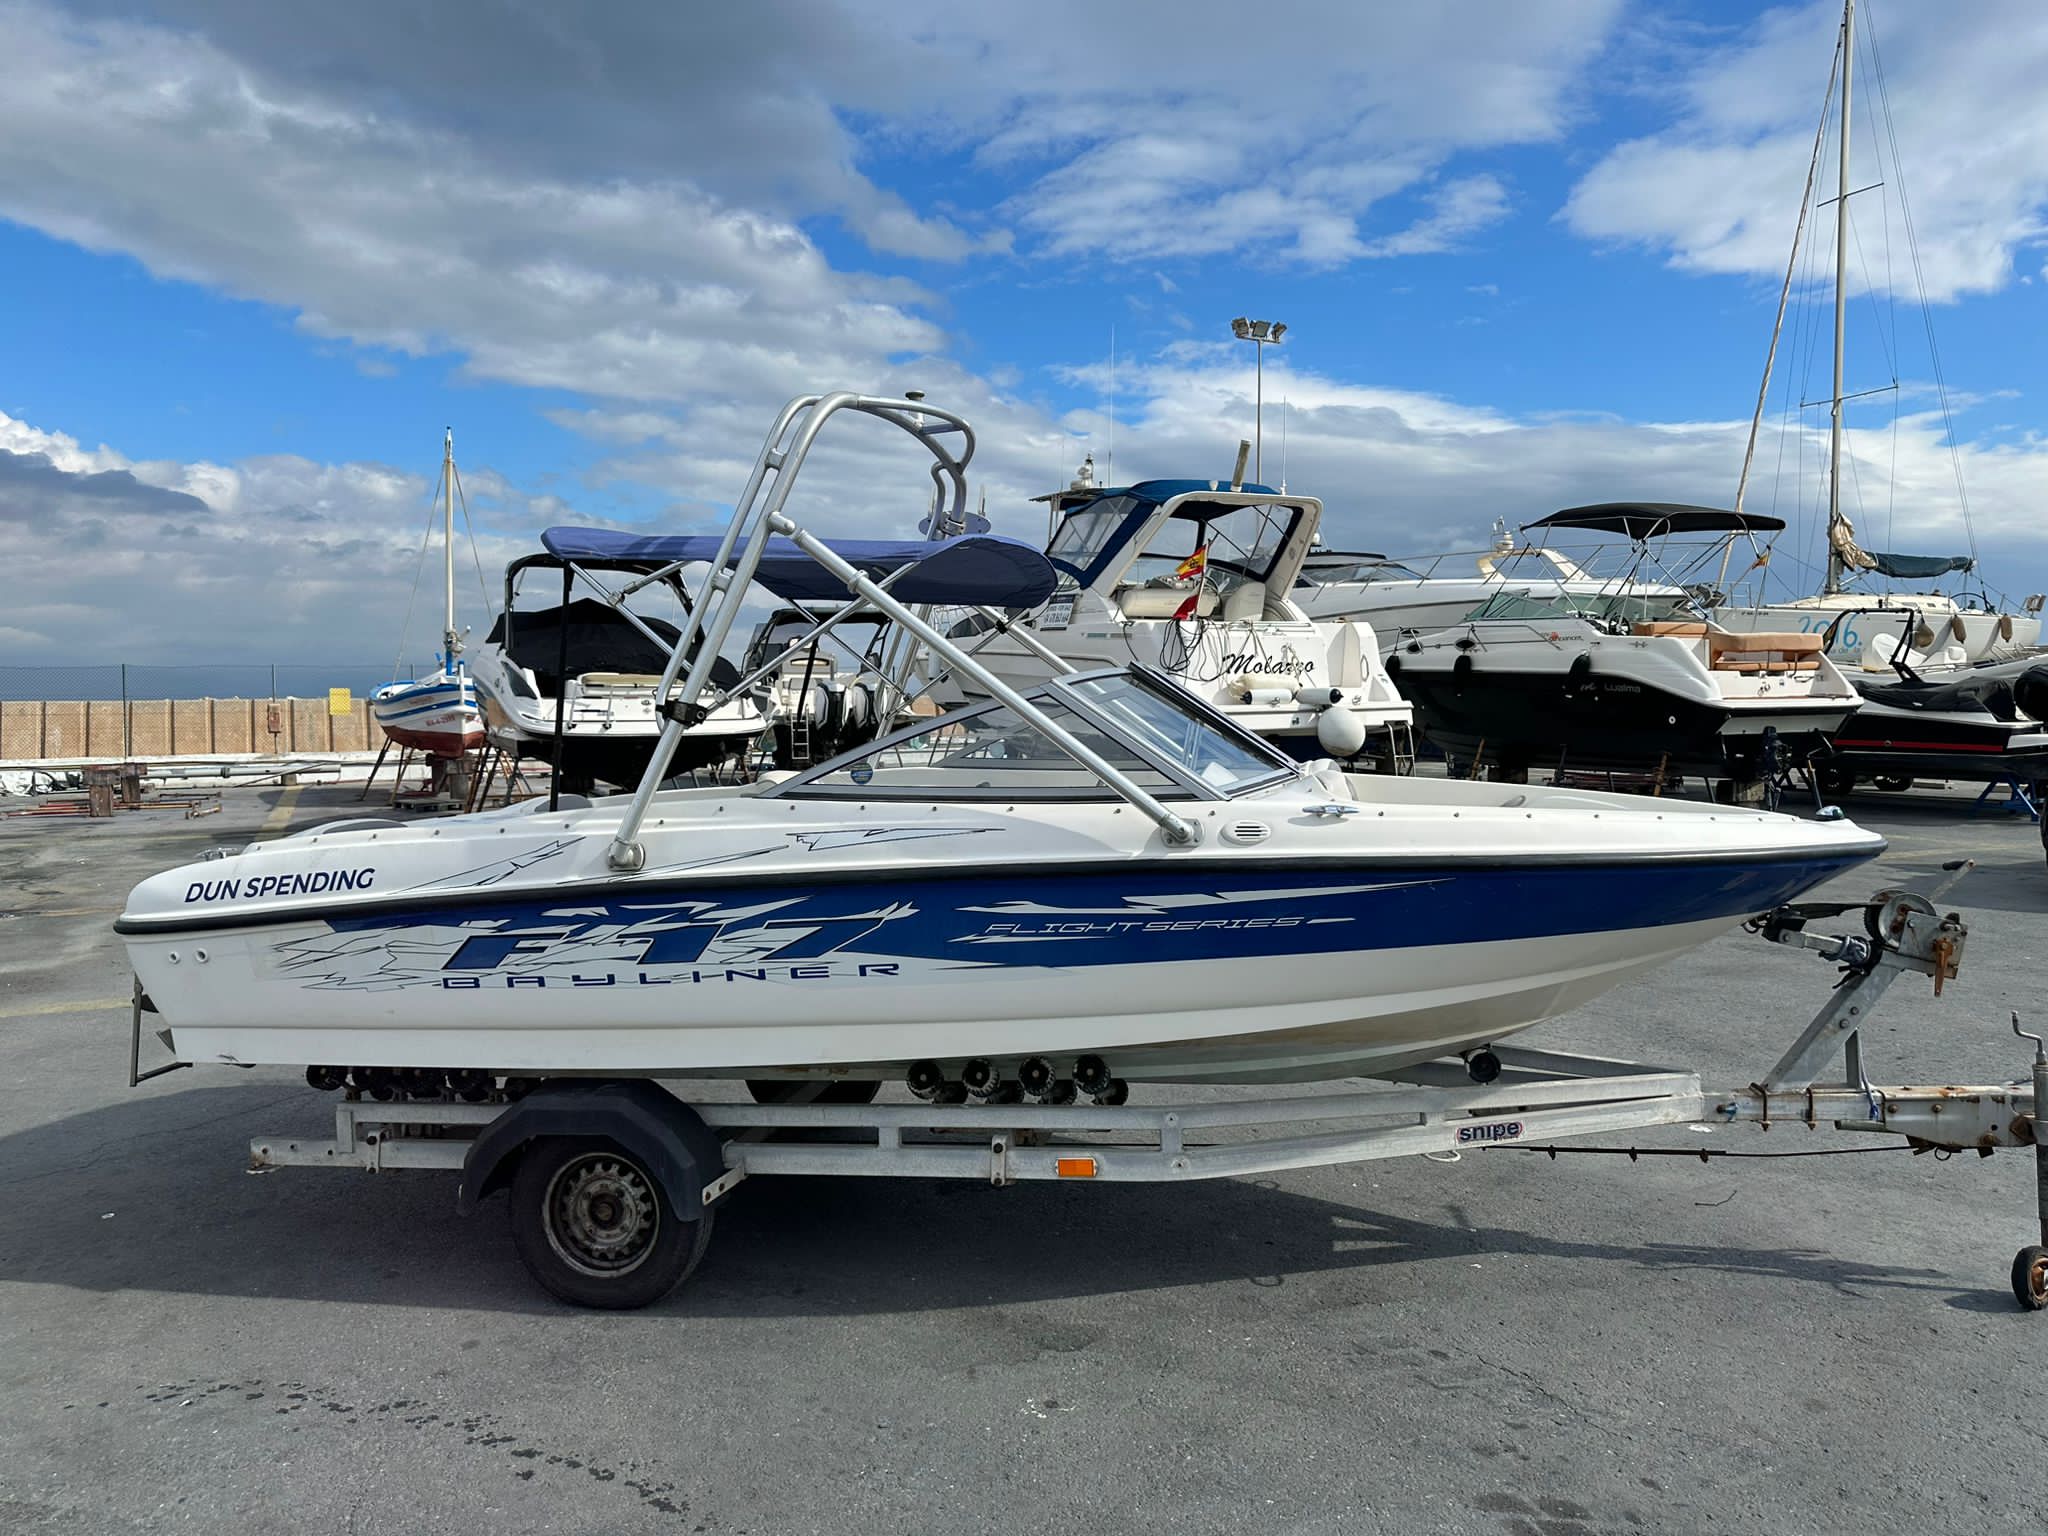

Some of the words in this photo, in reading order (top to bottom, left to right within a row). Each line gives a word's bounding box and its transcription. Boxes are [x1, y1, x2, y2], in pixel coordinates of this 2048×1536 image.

[184, 879, 241, 902] DUN
[244, 868, 376, 897] SPENDING
[442, 963, 900, 989] BAYLINER
[1460, 1122, 1519, 1141] snipe
